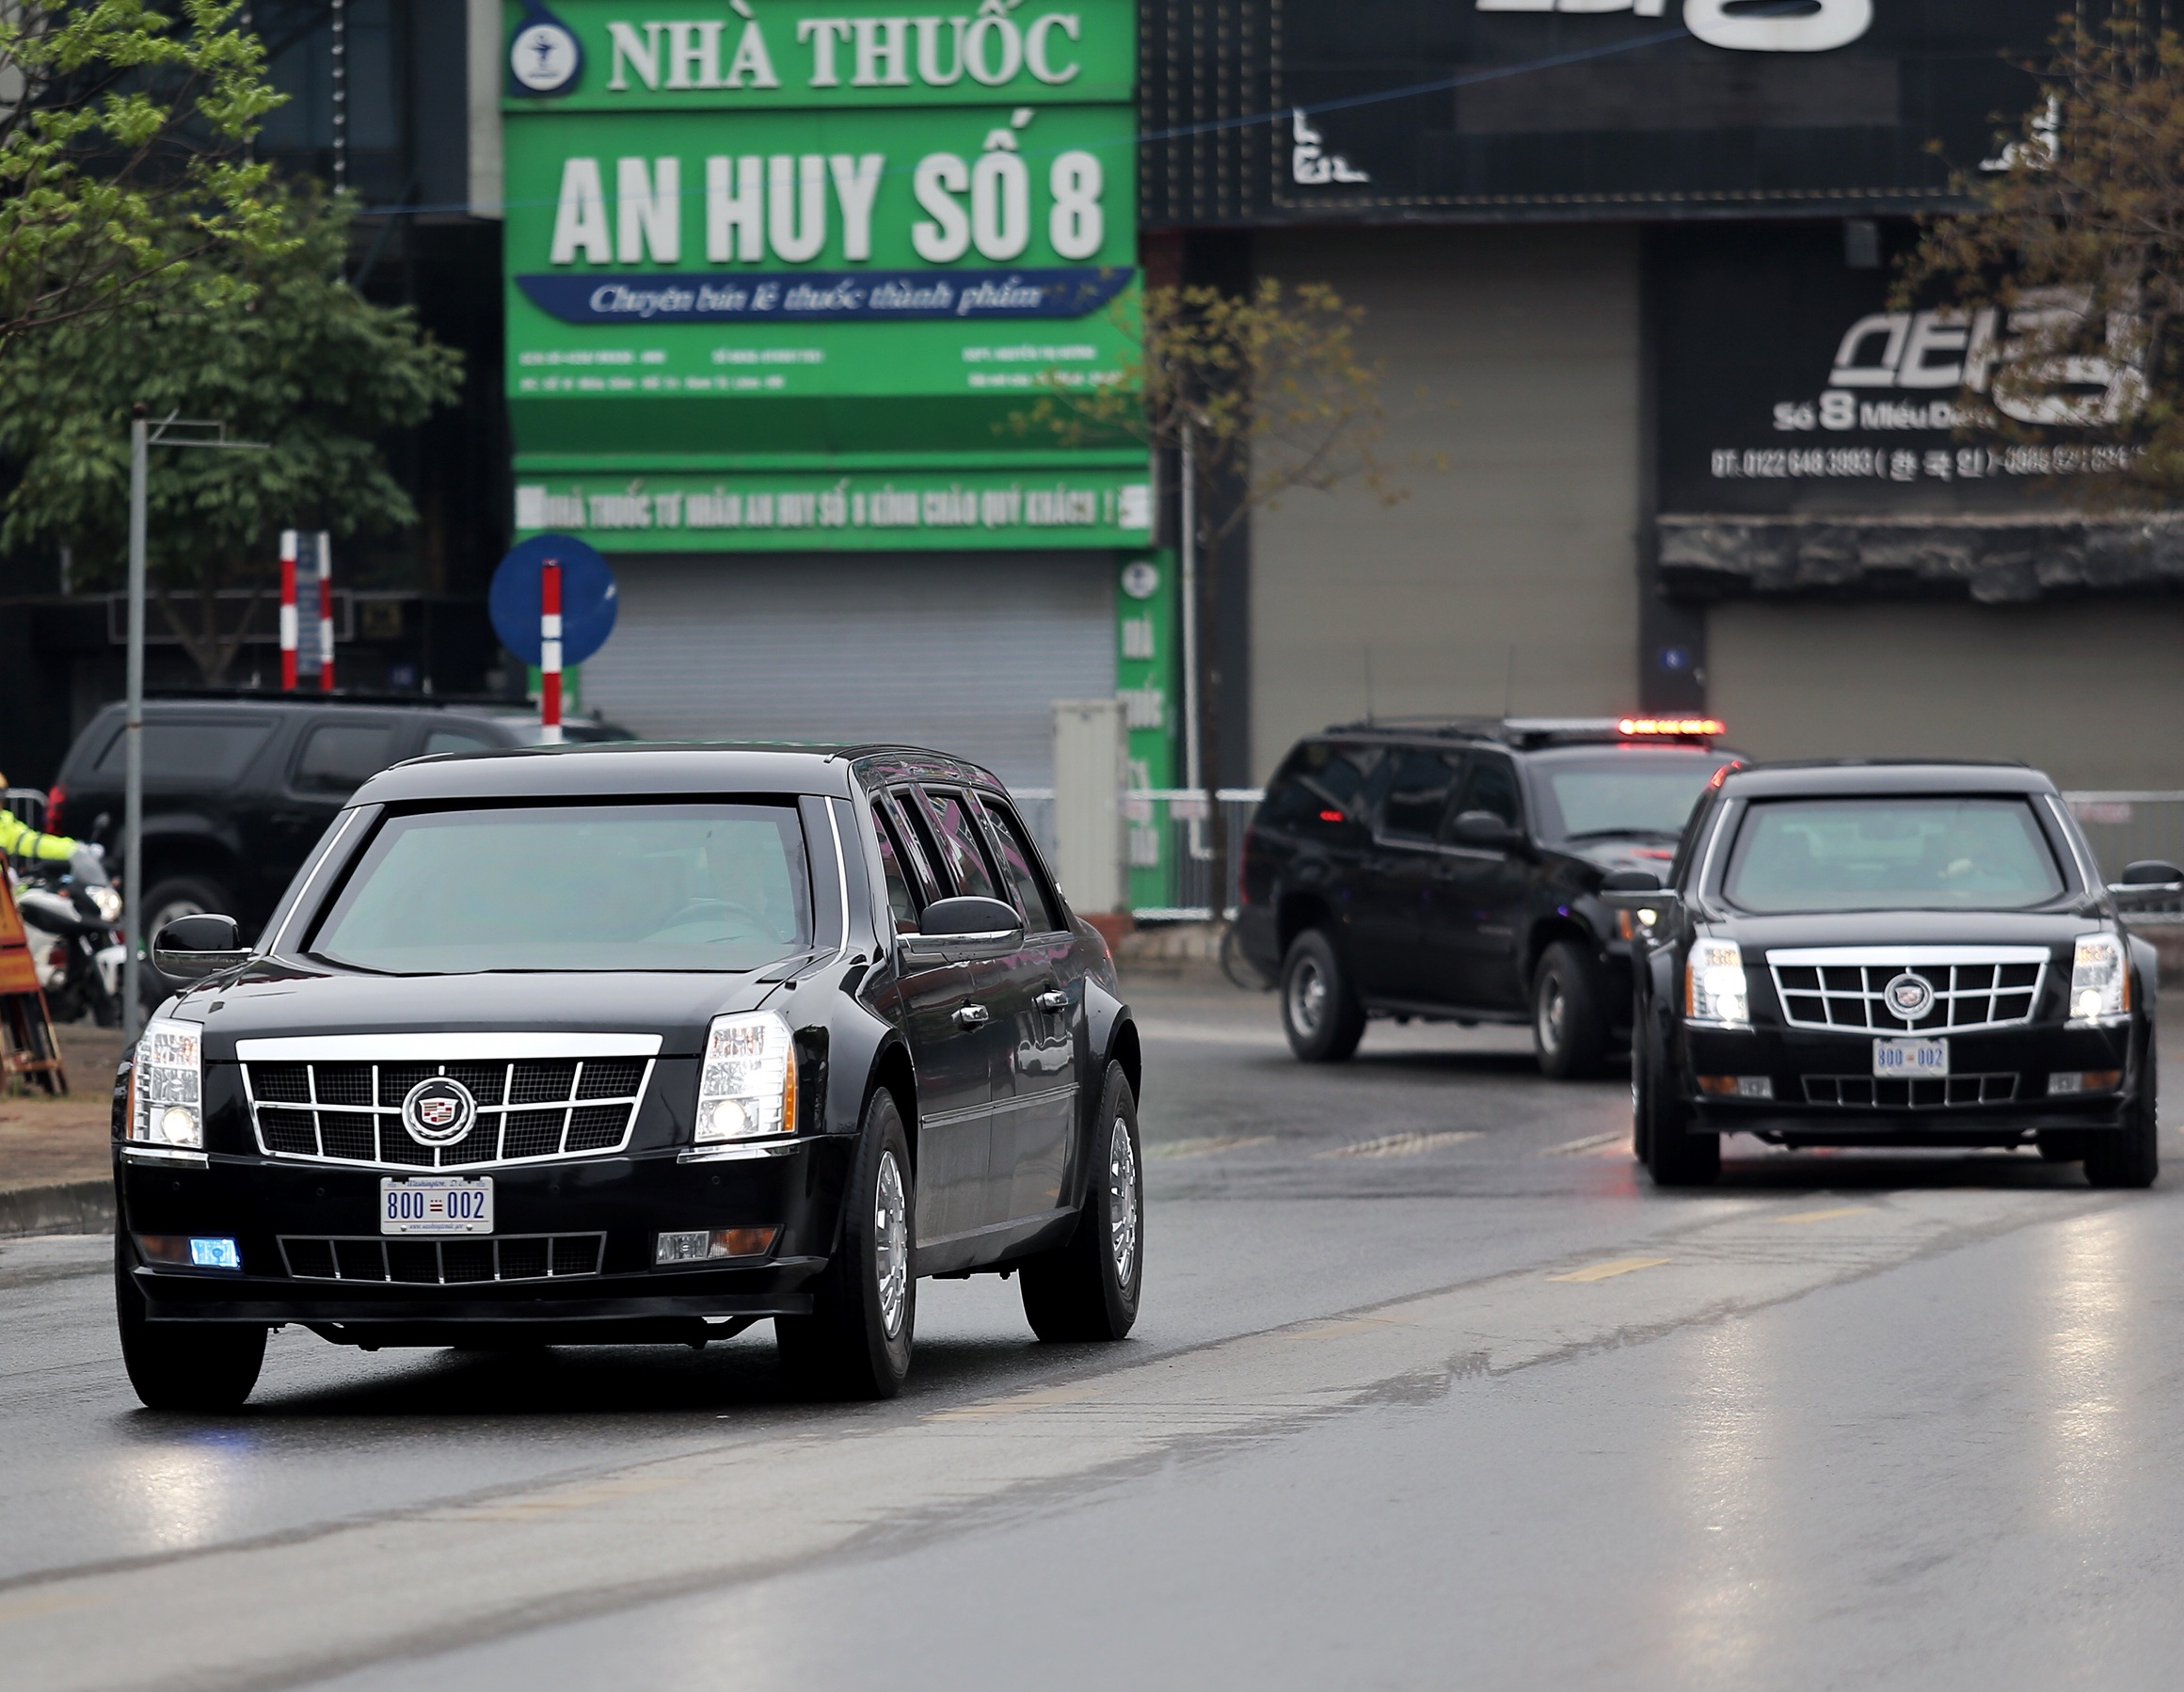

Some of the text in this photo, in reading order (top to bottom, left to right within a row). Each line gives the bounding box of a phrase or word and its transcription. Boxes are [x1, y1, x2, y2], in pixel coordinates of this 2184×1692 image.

[607, 0, 1080, 89] NHÀ THUỐC
[551, 108, 1105, 263] AN HUY SỐ 8
[589, 283, 694, 318] Chuyên
[783, 279, 867, 311] thuốc
[868, 279, 954, 310] thành
[1819, 390, 1857, 431] 8
[1877, 1048, 1943, 1067] 800 002
[387, 1191, 485, 1220] 800 002
